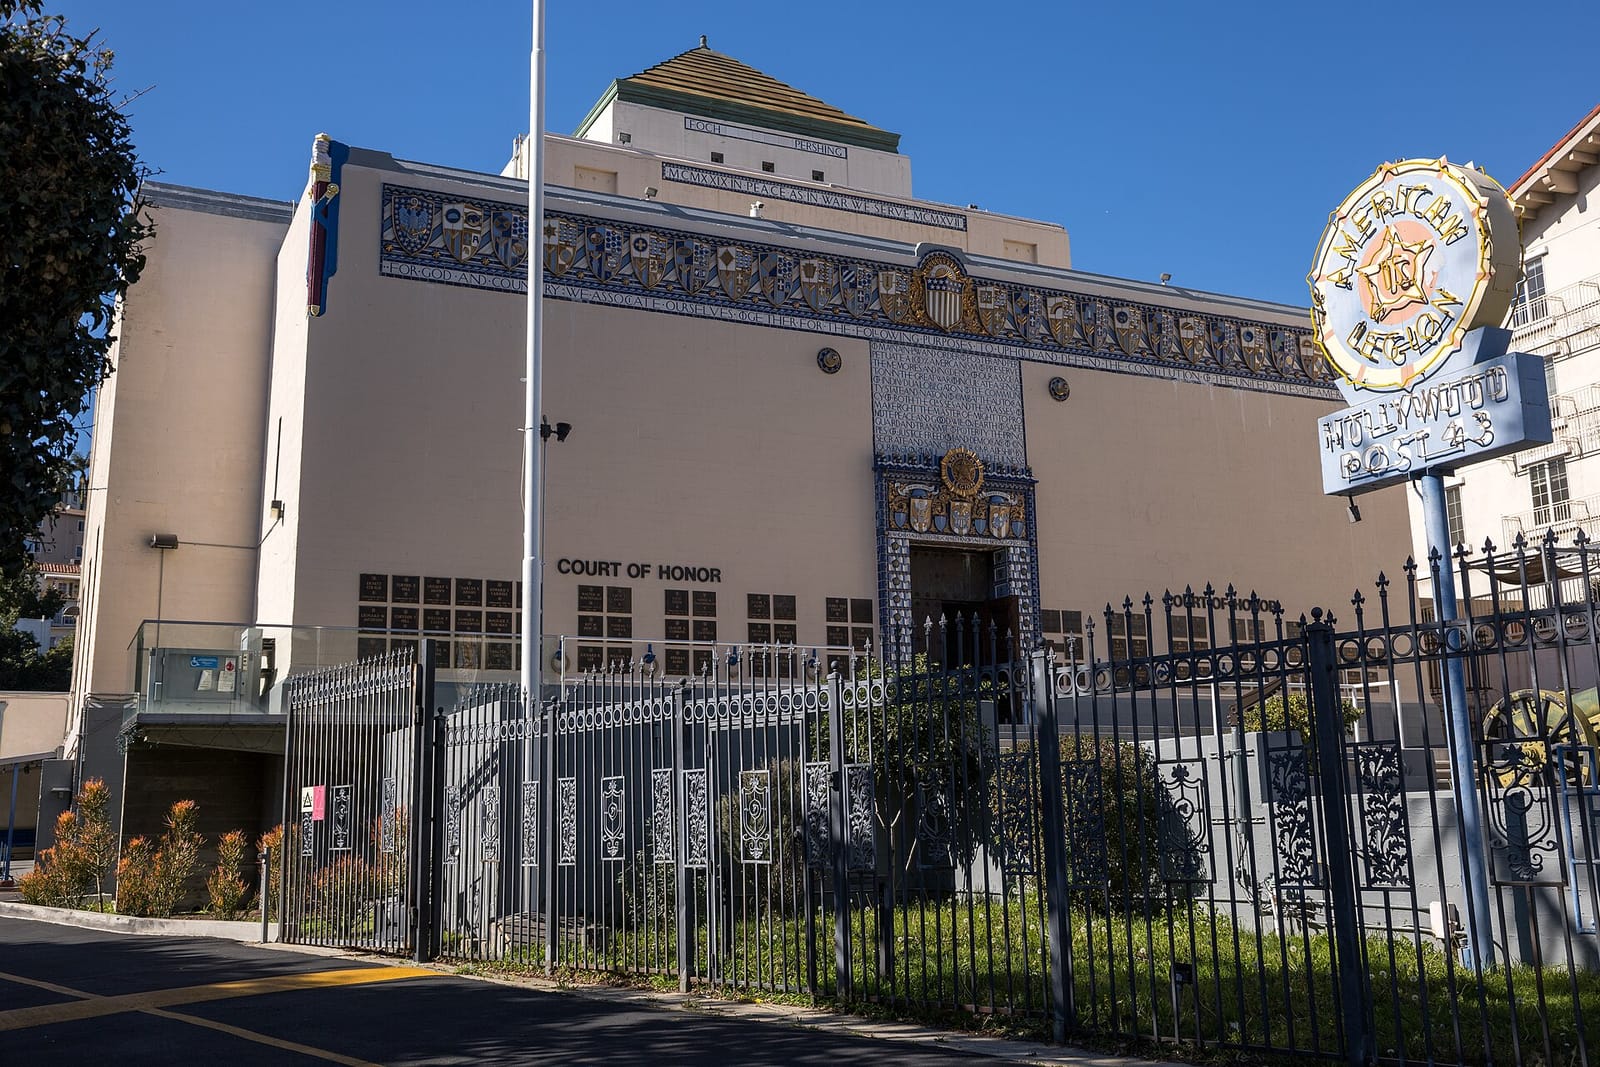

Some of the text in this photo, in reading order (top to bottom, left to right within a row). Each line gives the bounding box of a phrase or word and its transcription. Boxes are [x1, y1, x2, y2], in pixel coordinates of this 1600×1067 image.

[688, 118, 721, 134] FOCH
[794, 139, 844, 157] PERSHING
[668, 167, 728, 187] MCMXXIX
[730, 179, 742, 189] IN
[746, 182, 786, 197] PEACE
[789, 189, 803, 200] AS
[807, 191, 818, 203] IN
[821, 194, 848, 209] WAR
[852, 200, 868, 211] WE
[874, 203, 909, 218] SERVE
[1326, 183, 1469, 291] AMERICAN
[389, 262, 418, 274] FOR
[421, 267, 451, 280] GOD
[458, 272, 487, 285] AND
[491, 277, 561, 296] COUNRY
[567, 286, 589, 298] WE
[665, 301, 734, 319] OURSELVES
[799, 319, 824, 330] FOR
[828, 323, 851, 334] THE
[856, 326, 919, 343] FOLLOWING
[923, 335, 972, 350] PURPOSES
[1038, 351, 1058, 362] AND
[1061, 354, 1101, 367] DEFEND
[1104, 360, 1124, 370] THE
[1214, 374, 1233, 385] THE
[1316, 388, 1344, 400] AMER
[1346, 288, 1463, 366] LEGION
[1323, 366, 1508, 452] HOLLYWOOD
[1340, 411, 1494, 484] POST 43
[557, 558, 722, 583] COURT OF HONOR
[1213, 597, 1228, 610] OF
